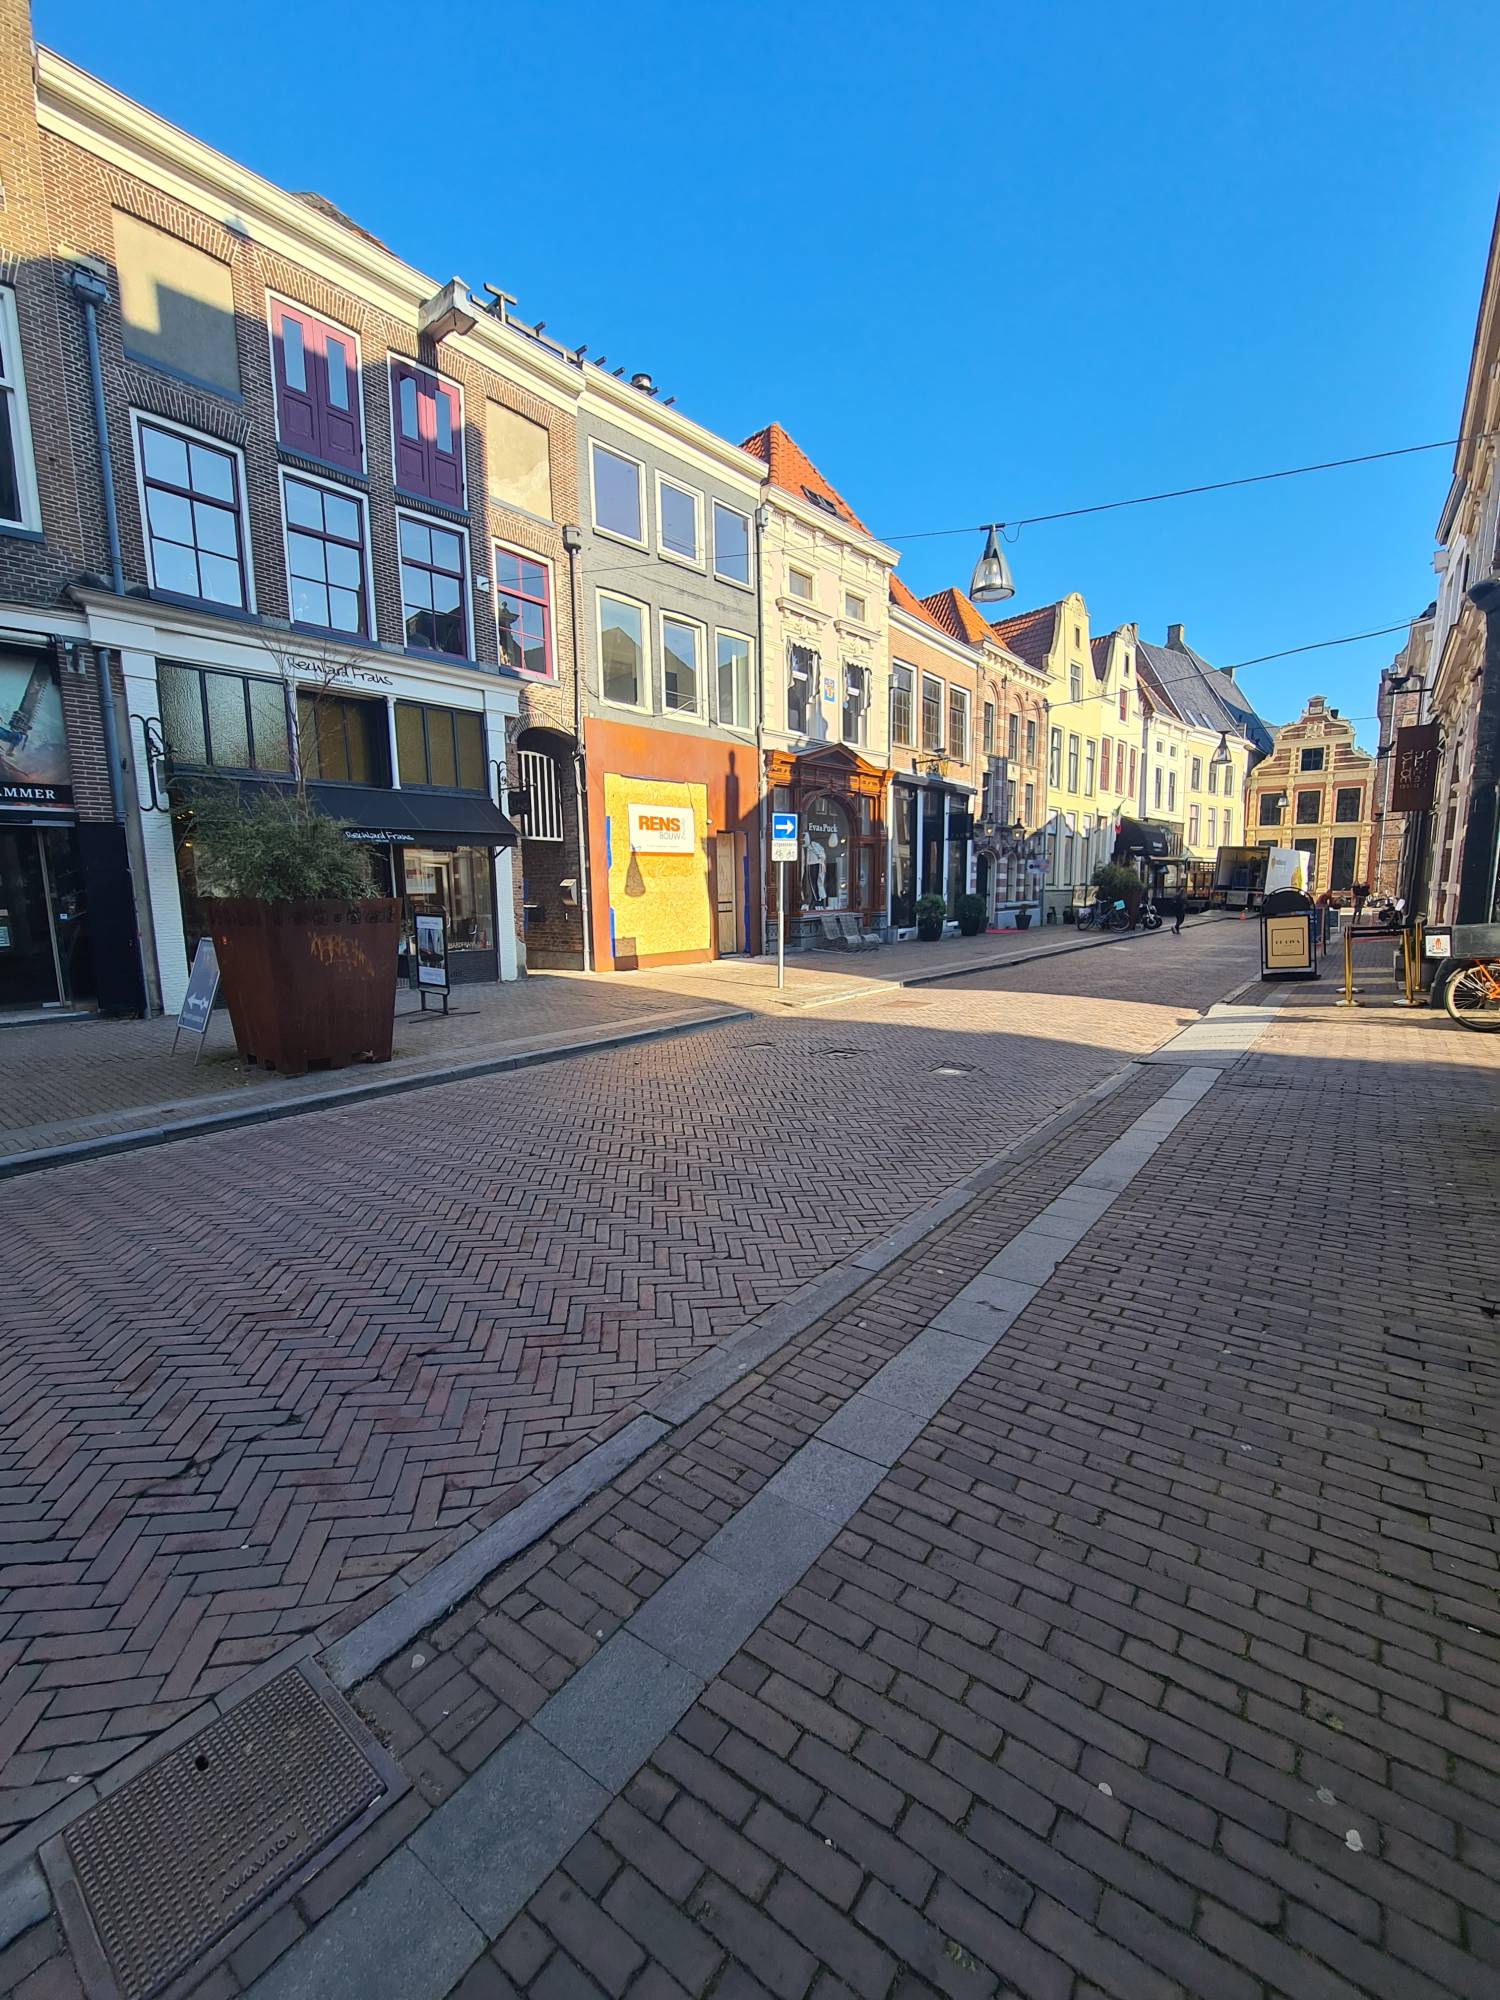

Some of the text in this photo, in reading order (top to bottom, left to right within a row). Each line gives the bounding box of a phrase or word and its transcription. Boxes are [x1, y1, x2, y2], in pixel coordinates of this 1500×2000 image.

[351, 664, 393, 686] Frans
[0, 786, 56, 800] MMER
[638, 815, 681, 832] RENS
[659, 832, 681, 840] BOUW
[222, 1831, 297, 1903] AQUAWAY
